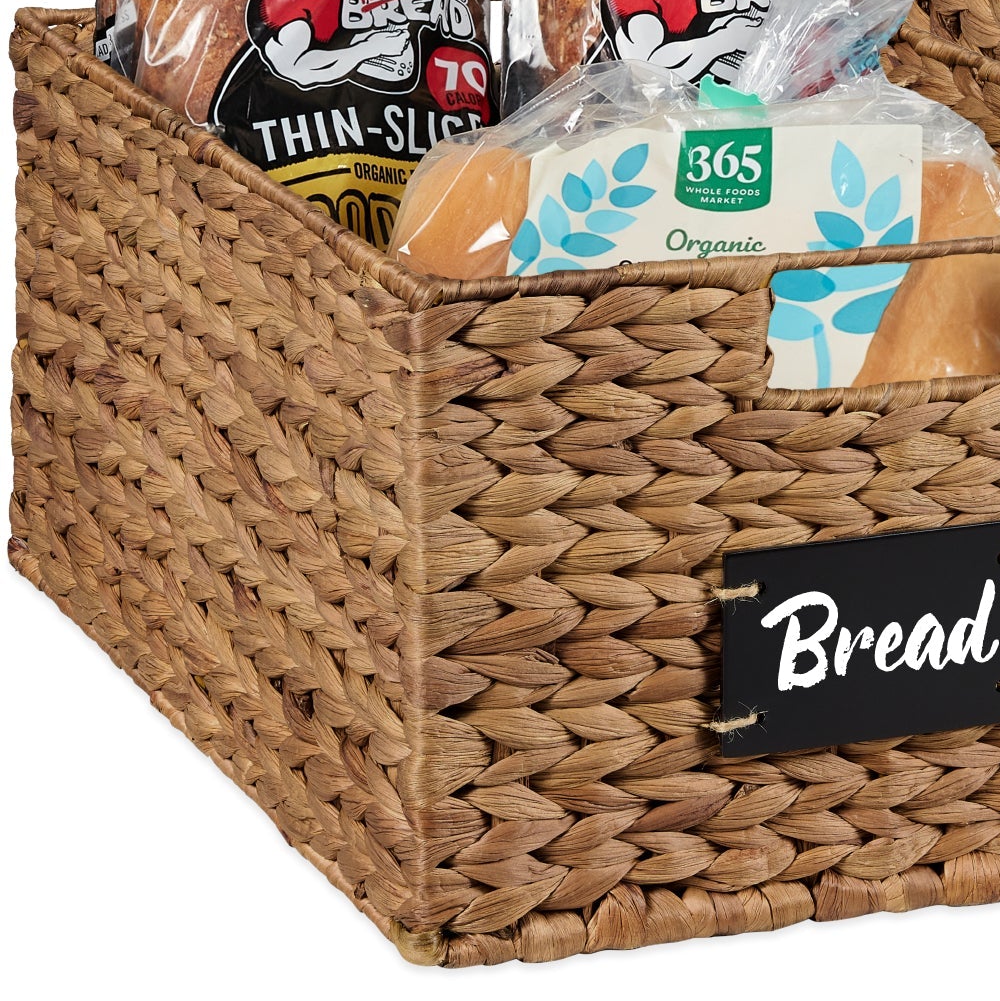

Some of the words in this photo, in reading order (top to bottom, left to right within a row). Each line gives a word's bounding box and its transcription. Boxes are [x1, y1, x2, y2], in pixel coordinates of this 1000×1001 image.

[434, 56, 487, 97] 70
[354, 162, 407, 185] ORGANIC
[686, 141, 762, 183] 365
[685, 186, 721, 195] WHOLE
[700, 196, 743, 204] MARKET
[666, 228, 766, 259] Organic
[761, 579, 999, 691] Bread
